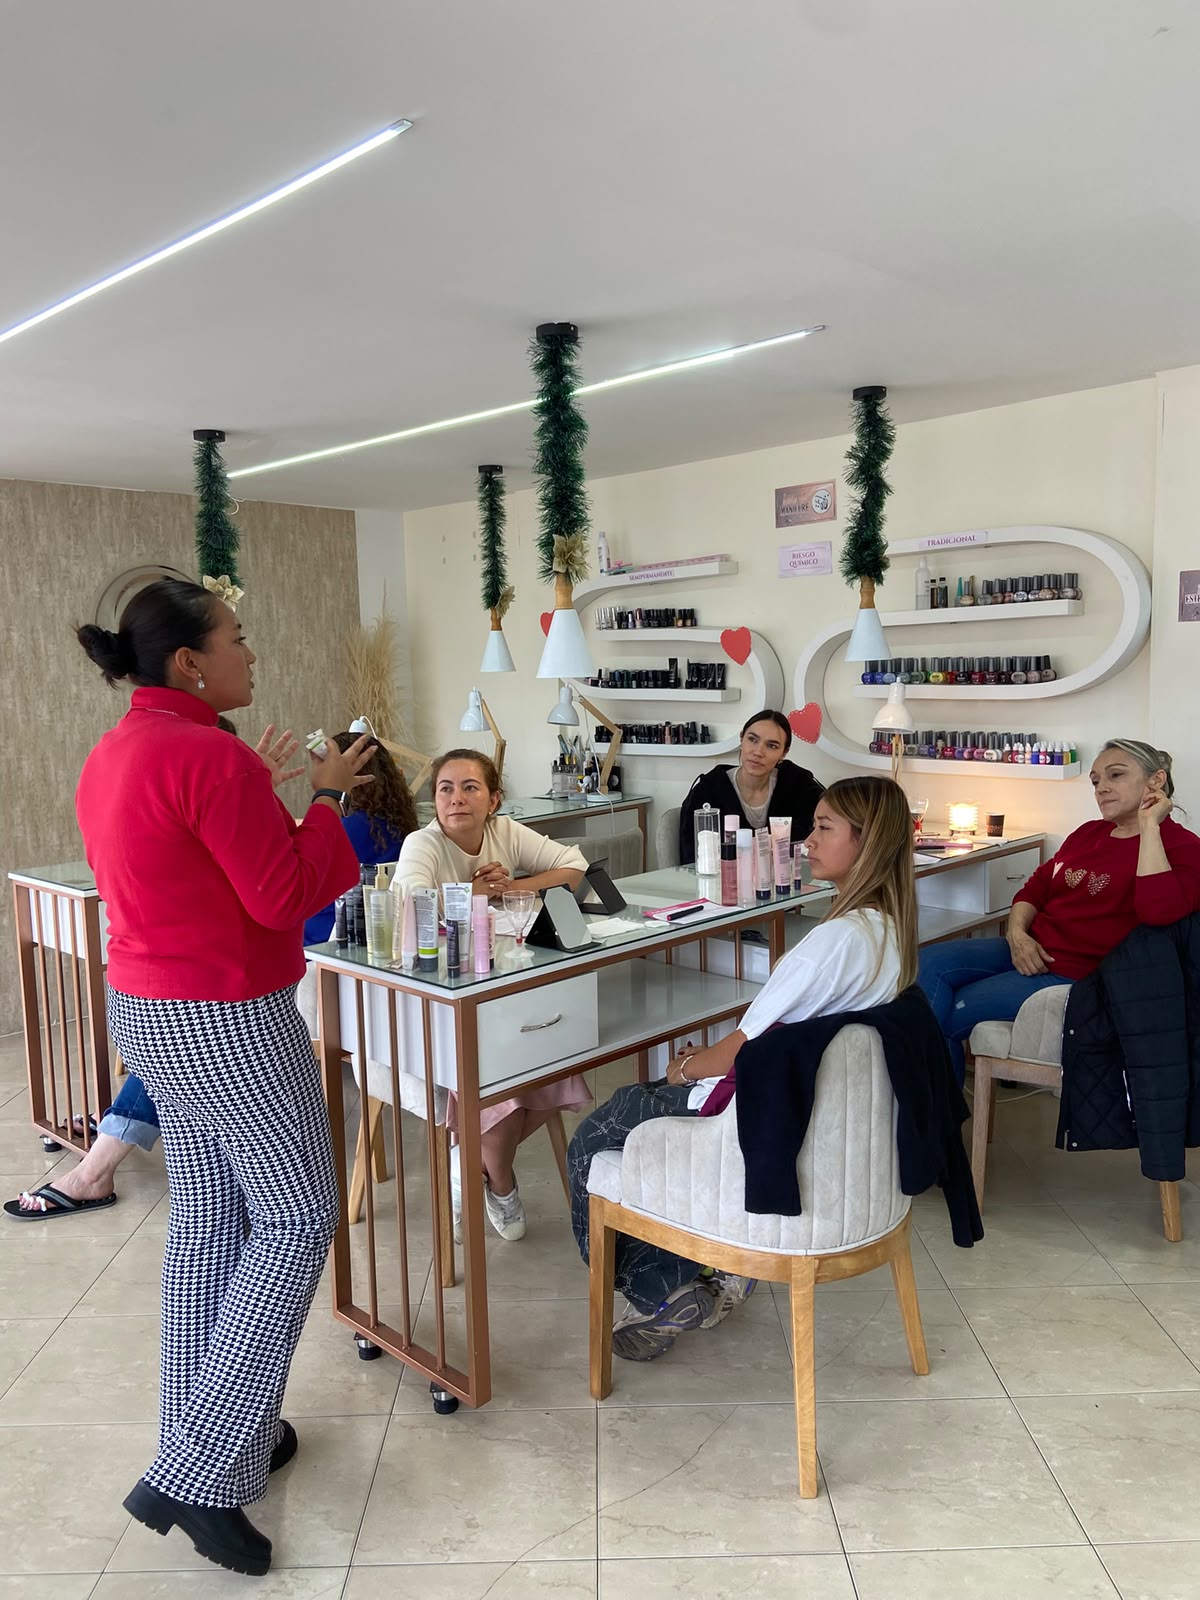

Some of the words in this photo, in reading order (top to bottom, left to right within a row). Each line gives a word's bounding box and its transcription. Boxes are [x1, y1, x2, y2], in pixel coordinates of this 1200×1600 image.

[927, 535, 976, 547] TRADICIONAL
[792, 551, 815, 560] RIESGO
[629, 570, 673, 581] SEMIPERMANENTE
